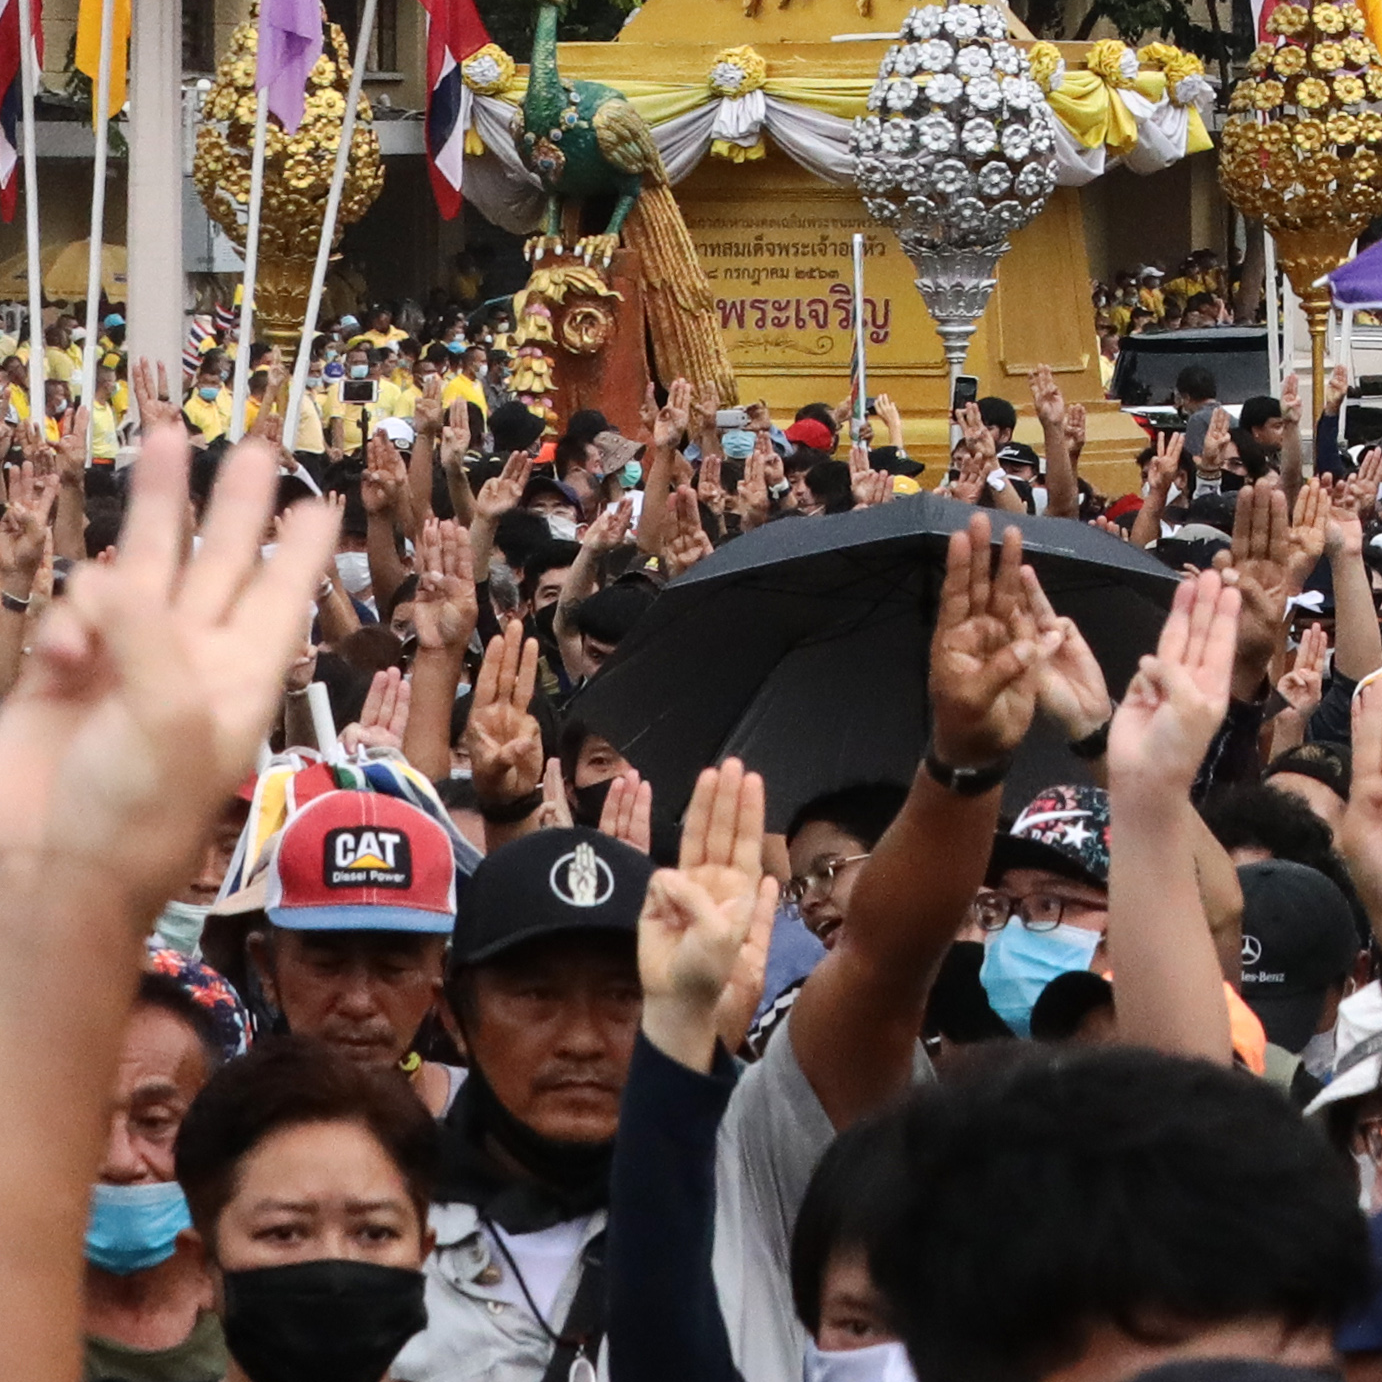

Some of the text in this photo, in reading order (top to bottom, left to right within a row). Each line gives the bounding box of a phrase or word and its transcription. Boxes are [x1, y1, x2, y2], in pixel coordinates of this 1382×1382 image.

[723, 267, 790, 286] กรกฎาคม
[795, 267, 840, 280] ๒๕๖๓
[335, 832, 401, 869] CAT
[332, 870, 406, 883] Diesel Power
